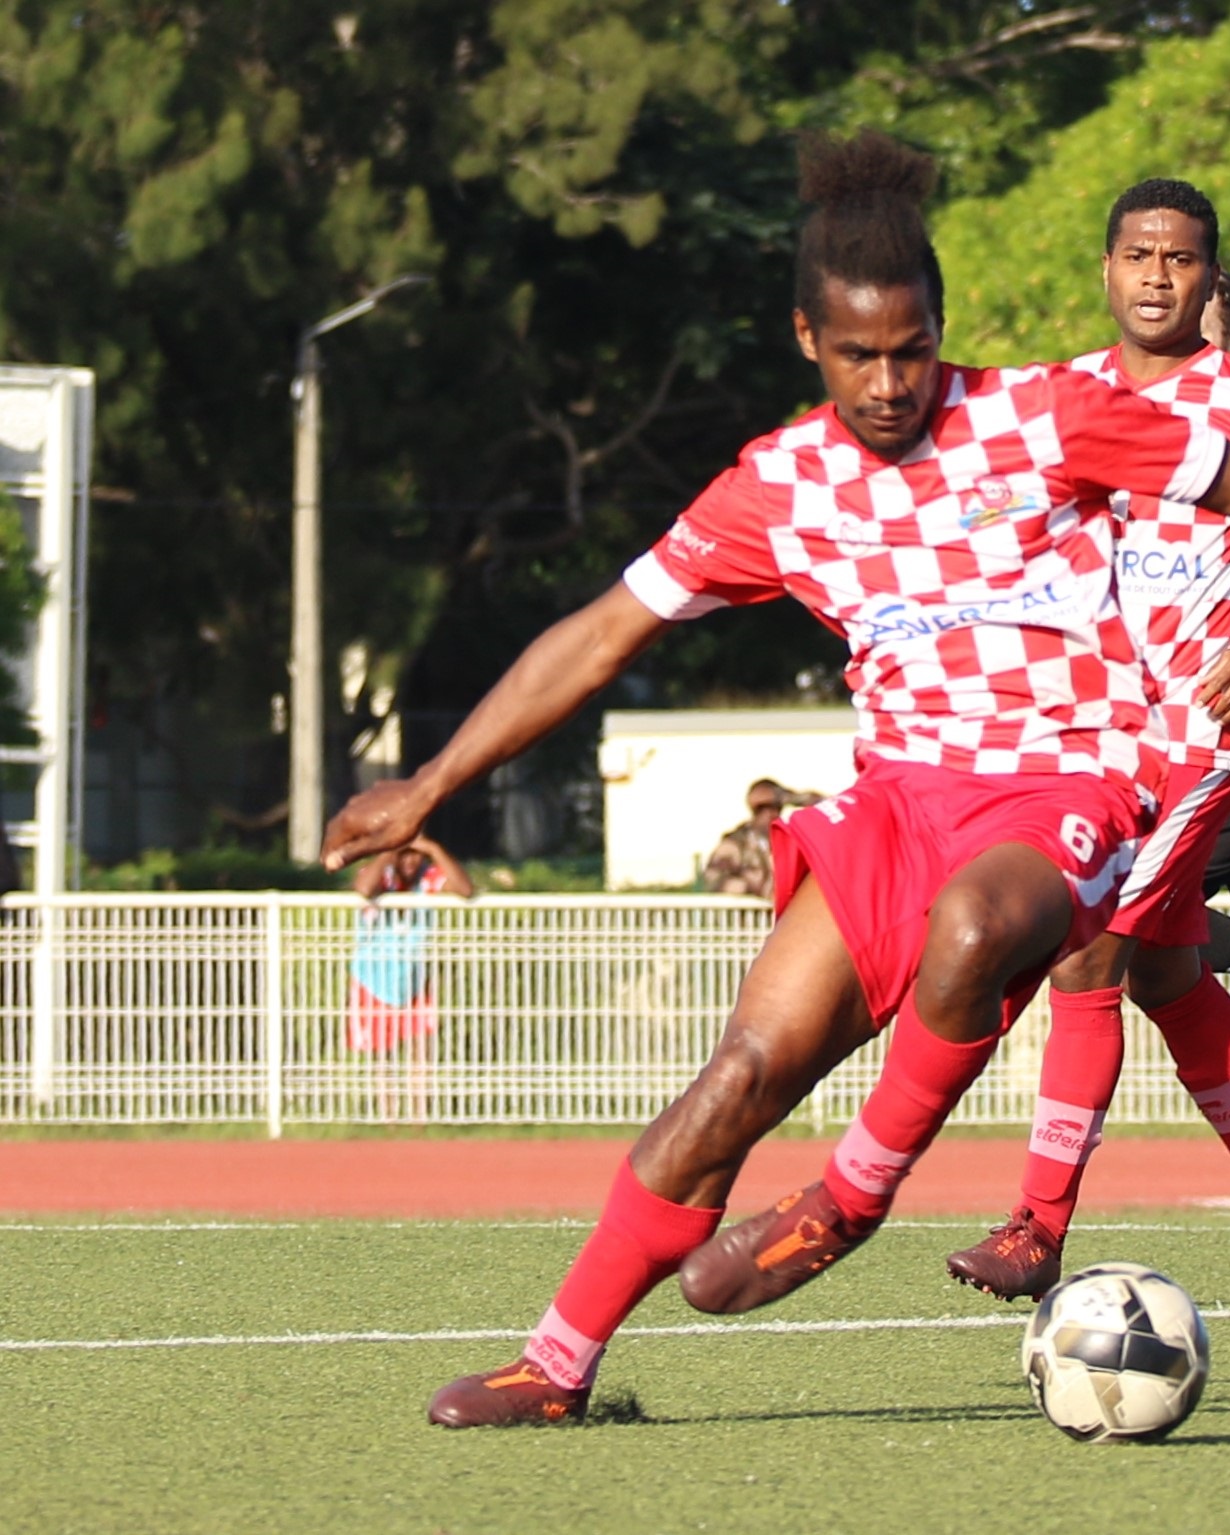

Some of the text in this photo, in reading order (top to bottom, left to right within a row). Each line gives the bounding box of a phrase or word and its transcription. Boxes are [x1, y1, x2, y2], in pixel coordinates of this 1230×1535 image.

[1113, 549, 1209, 580] RCAL
[1061, 814, 1097, 864] 6
[1036, 1128, 1089, 1152] eldera
